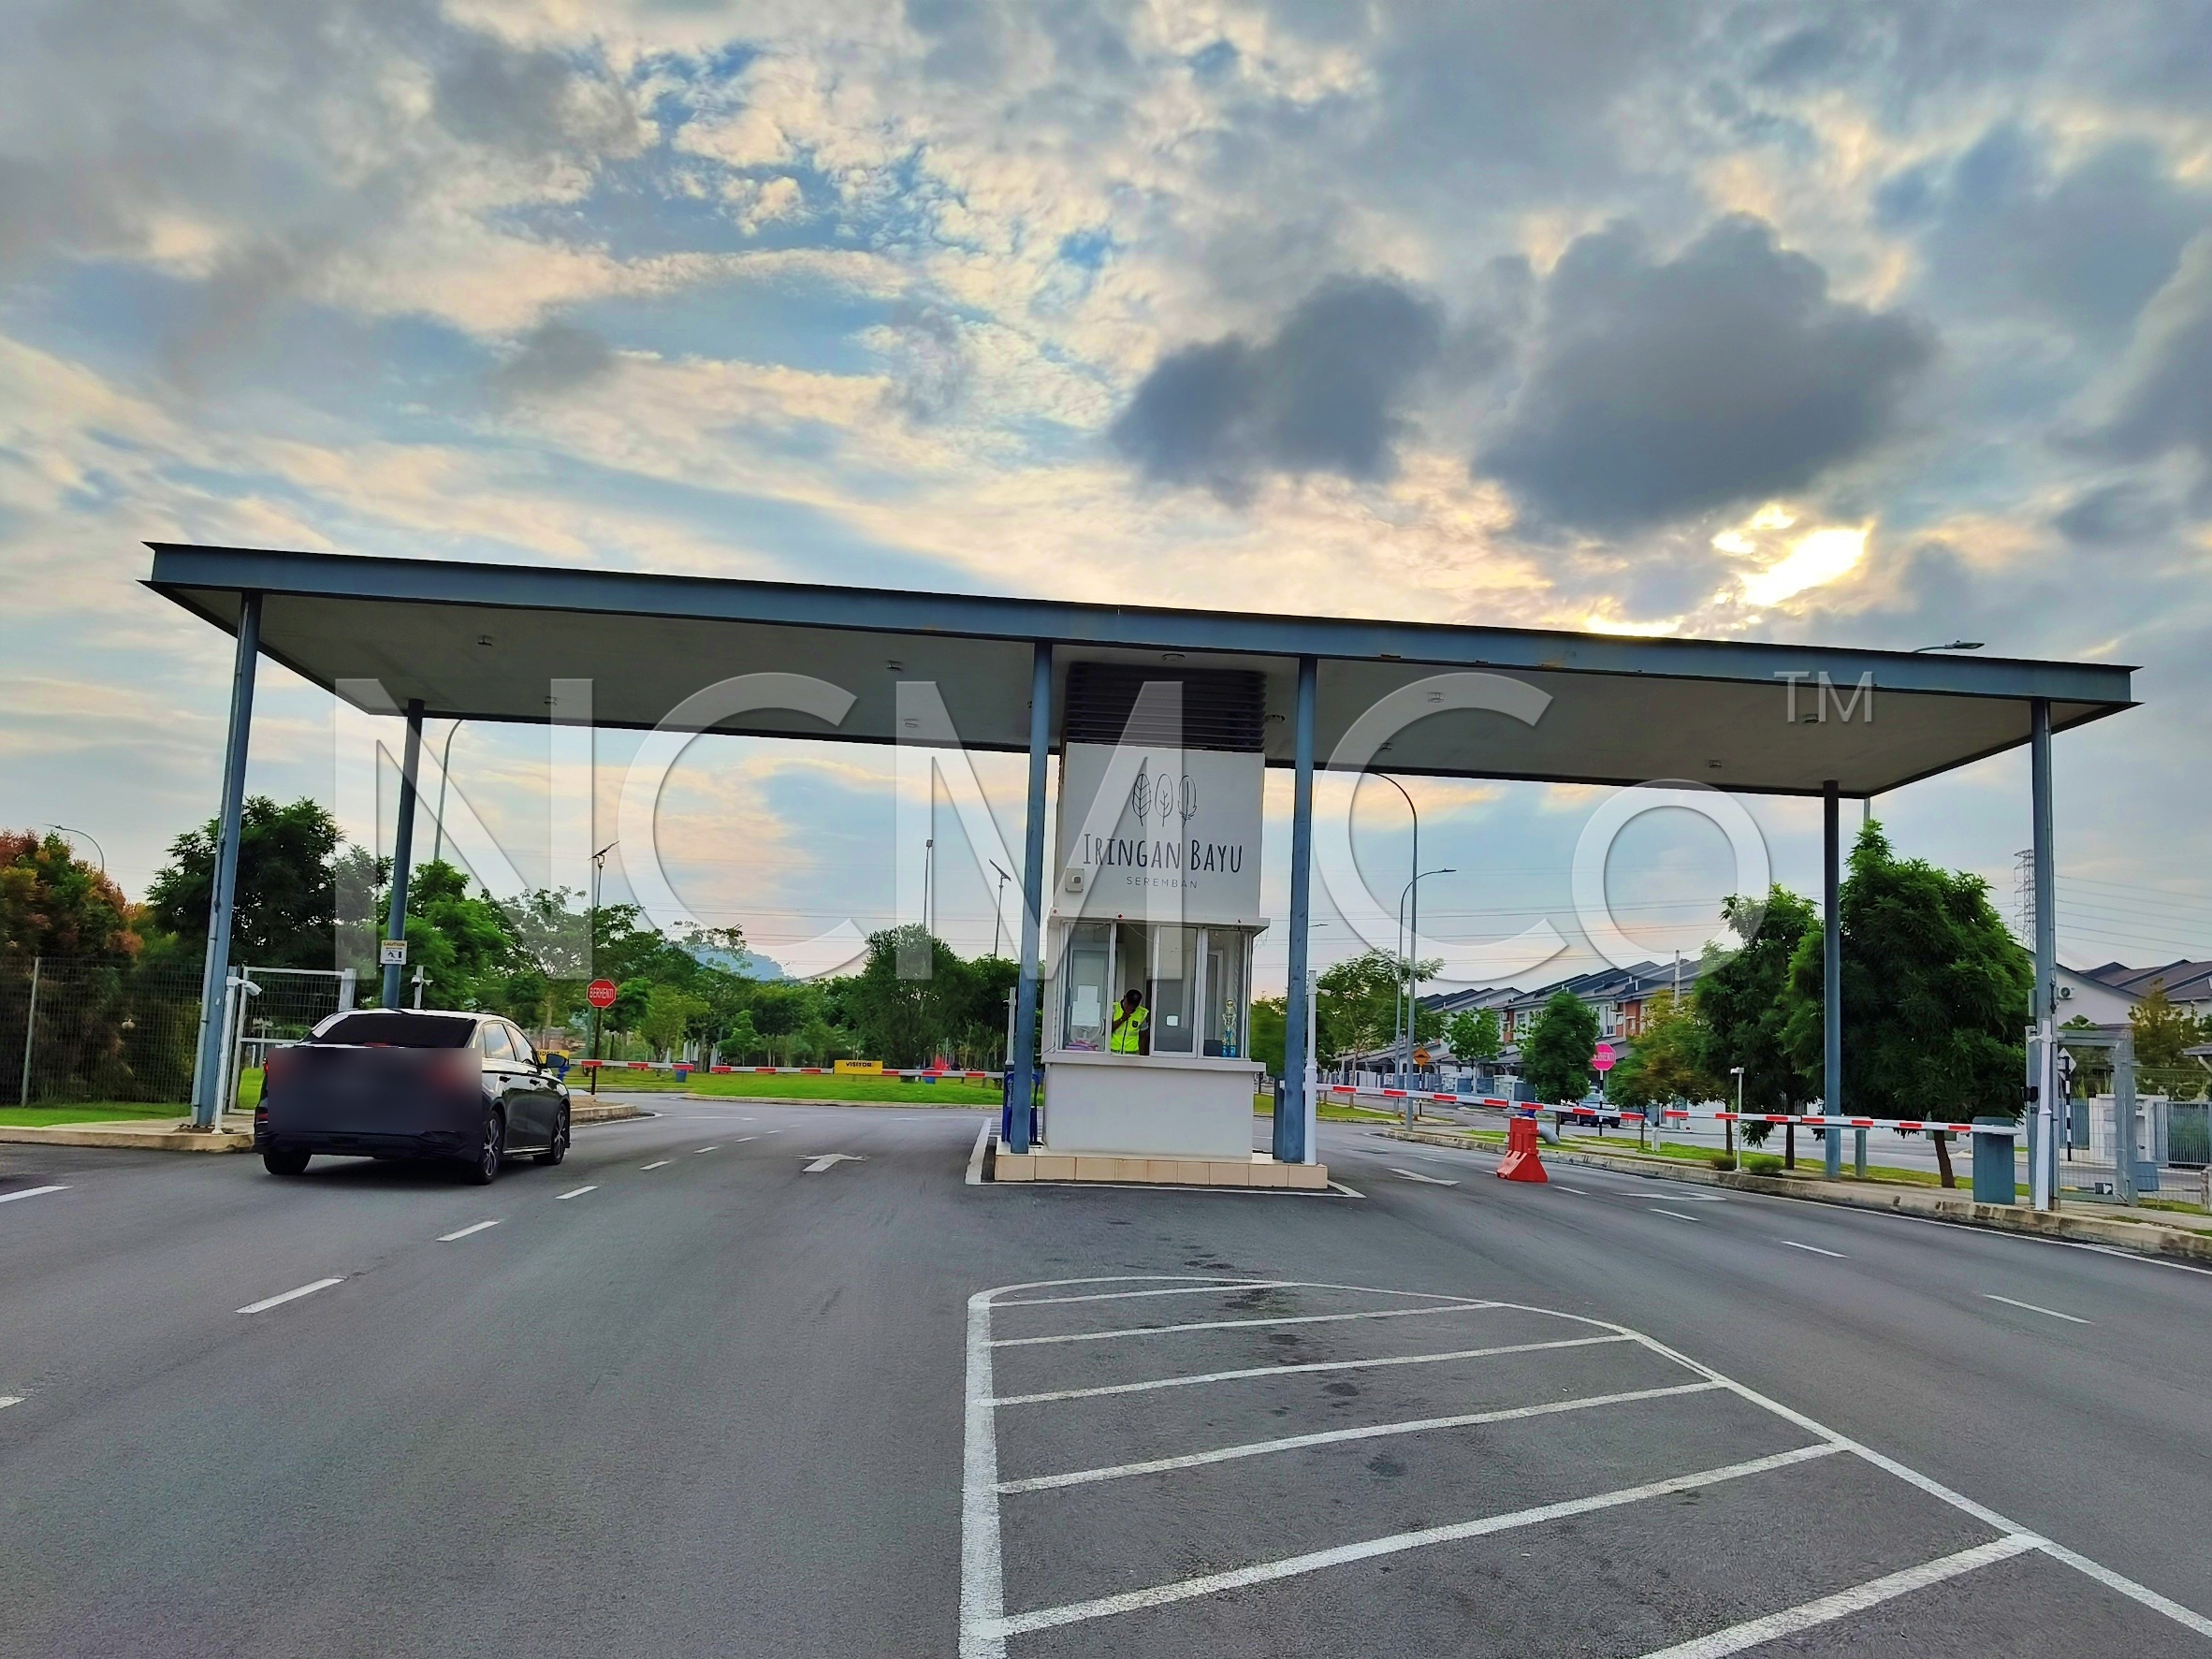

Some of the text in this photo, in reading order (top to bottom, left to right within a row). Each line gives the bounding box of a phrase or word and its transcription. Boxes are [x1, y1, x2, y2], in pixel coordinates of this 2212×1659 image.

[1083, 833, 1244, 873] IRINGAN BAYU
[1126, 876, 1199, 889] SEREMBAN
[589, 986, 614, 999] BERHENTI
